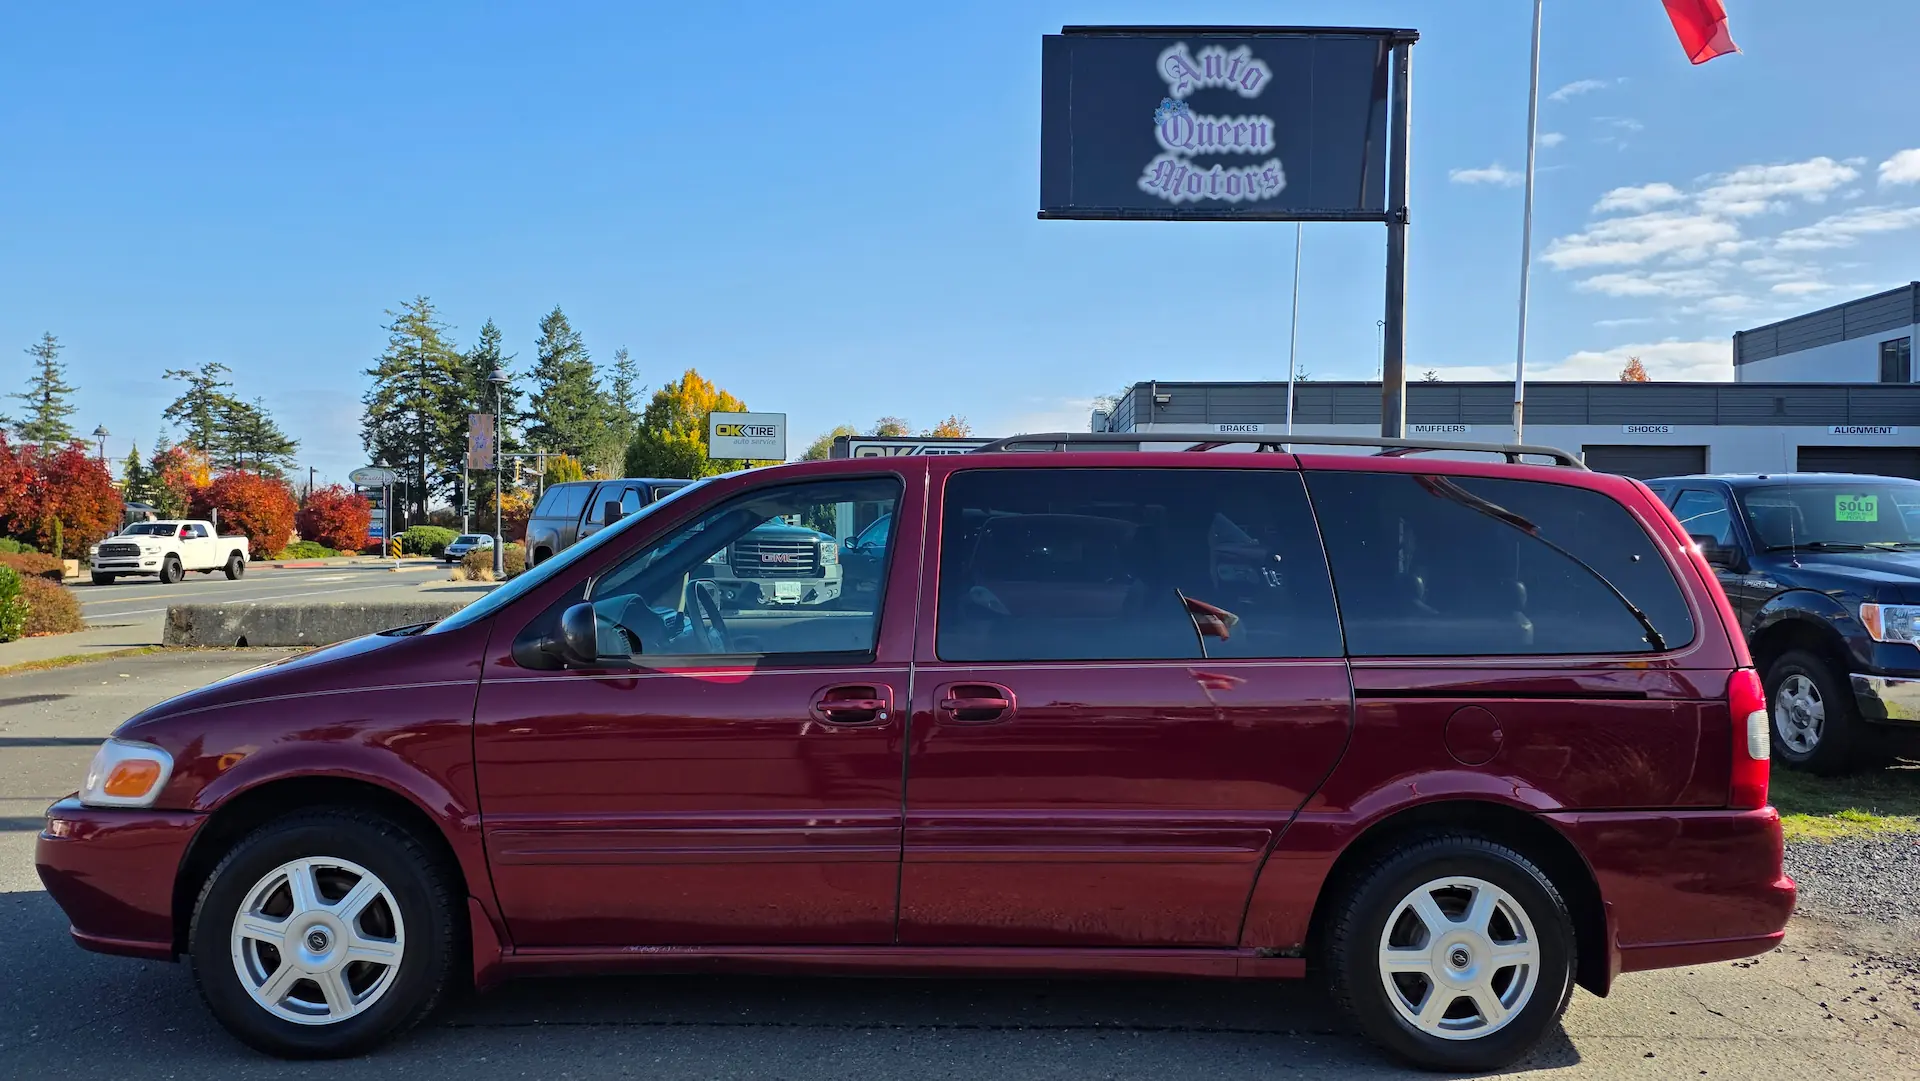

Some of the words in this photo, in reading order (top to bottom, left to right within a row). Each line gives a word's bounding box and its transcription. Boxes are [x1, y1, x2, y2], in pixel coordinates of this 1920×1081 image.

[1164, 50, 1264, 92] Auto
[1160, 113, 1268, 150] Queen
[1146, 159, 1280, 196] Motors
[716, 424, 743, 436] OK
[749, 426, 774, 436] TIRE
[1220, 424, 1258, 432] BRAKES
[1628, 425, 1669, 433] SHOCKS
[1834, 426, 1893, 434] ALIGNMENT
[1838, 501, 1874, 512] SOLD
[761, 552, 798, 563] GMC
